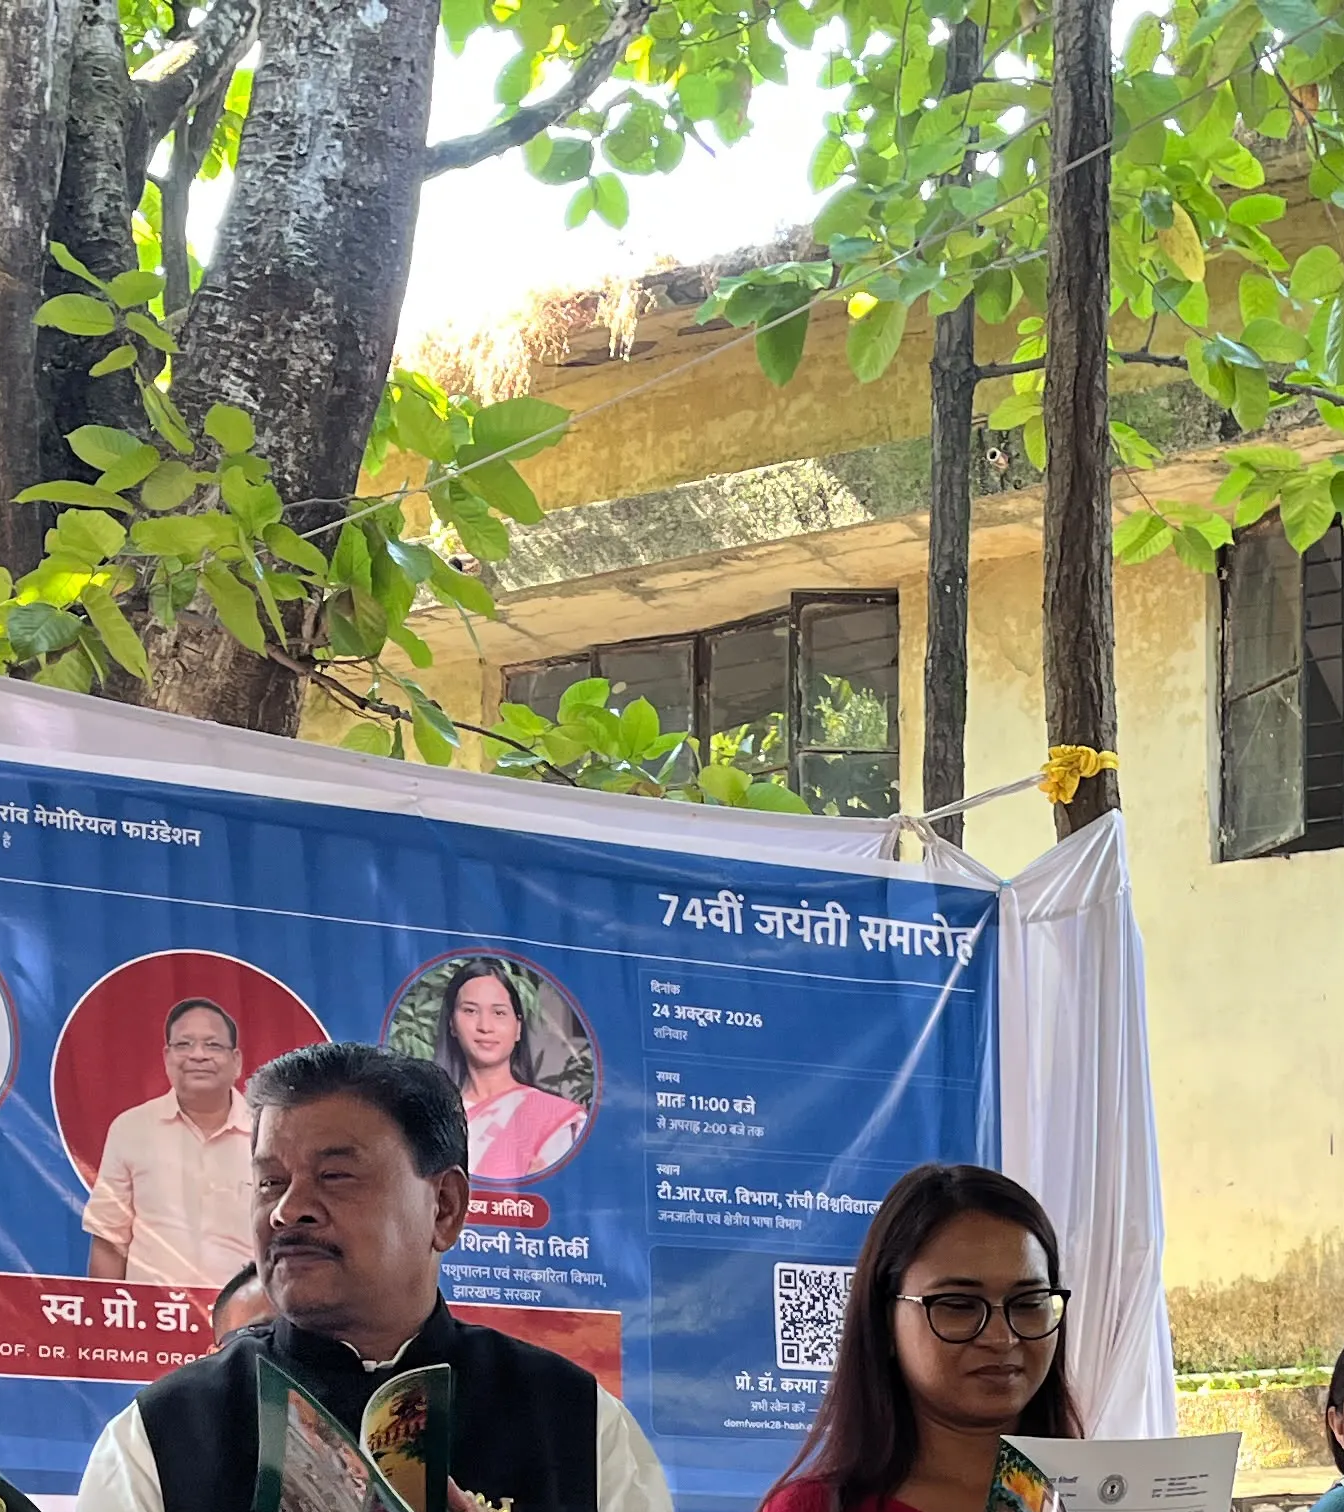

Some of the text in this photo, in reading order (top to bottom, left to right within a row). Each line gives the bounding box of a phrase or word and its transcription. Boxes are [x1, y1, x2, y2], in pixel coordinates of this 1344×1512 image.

[34, 804, 116, 836] मेमोरियल
[121, 820, 201, 847] फाउंडेशन
[2, 831, 11, 848] है
[658, 889, 976, 966] 74वीं जयंती समारोह
[650, 979, 681, 996] दिनांक
[652, 1003, 763, 1028] 24 अक्टूबर 2026
[653, 1026, 688, 1042] शनिवार
[656, 1071, 680, 1084] समय
[690, 1095, 730, 1112] 11:00
[733, 1096, 756, 1115] बजे
[656, 1115, 666, 1129] से
[703, 1122, 727, 1135] 2:00
[729, 1122, 745, 1136] बजे
[747, 1126, 765, 1138] तक
[656, 1164, 680, 1176] स्थान
[467, 1198, 534, 1218] ख्य अतिथि
[735, 1186, 782, 1210] विभाग,
[785, 1189, 814, 1209] रांची
[815, 1193, 881, 1215] विश्वविद्याल
[706, 1213, 720, 1226] एवं
[752, 1216, 773, 1229] भाषा
[775, 1215, 802, 1231] विभाग
[459, 1229, 589, 1259] शिल्पी नेहा तिर्की
[441, 1263, 607, 1288] पशुपालन एवं सहकारिता विभाग,
[452, 1285, 542, 1303] झारखण्ड सरकार
[40, 1293, 93, 1327] स्व.
[102, 1288, 147, 1330] प्रो.
[154, 1291, 199, 1333] डॉ.
[38, 1345, 70, 1359] DR.
[78, 1347, 149, 1363] KARMA
[735, 1371, 754, 1391] प्रो.
[757, 1372, 777, 1392] डॉ.
[780, 1377, 817, 1394] करमा
